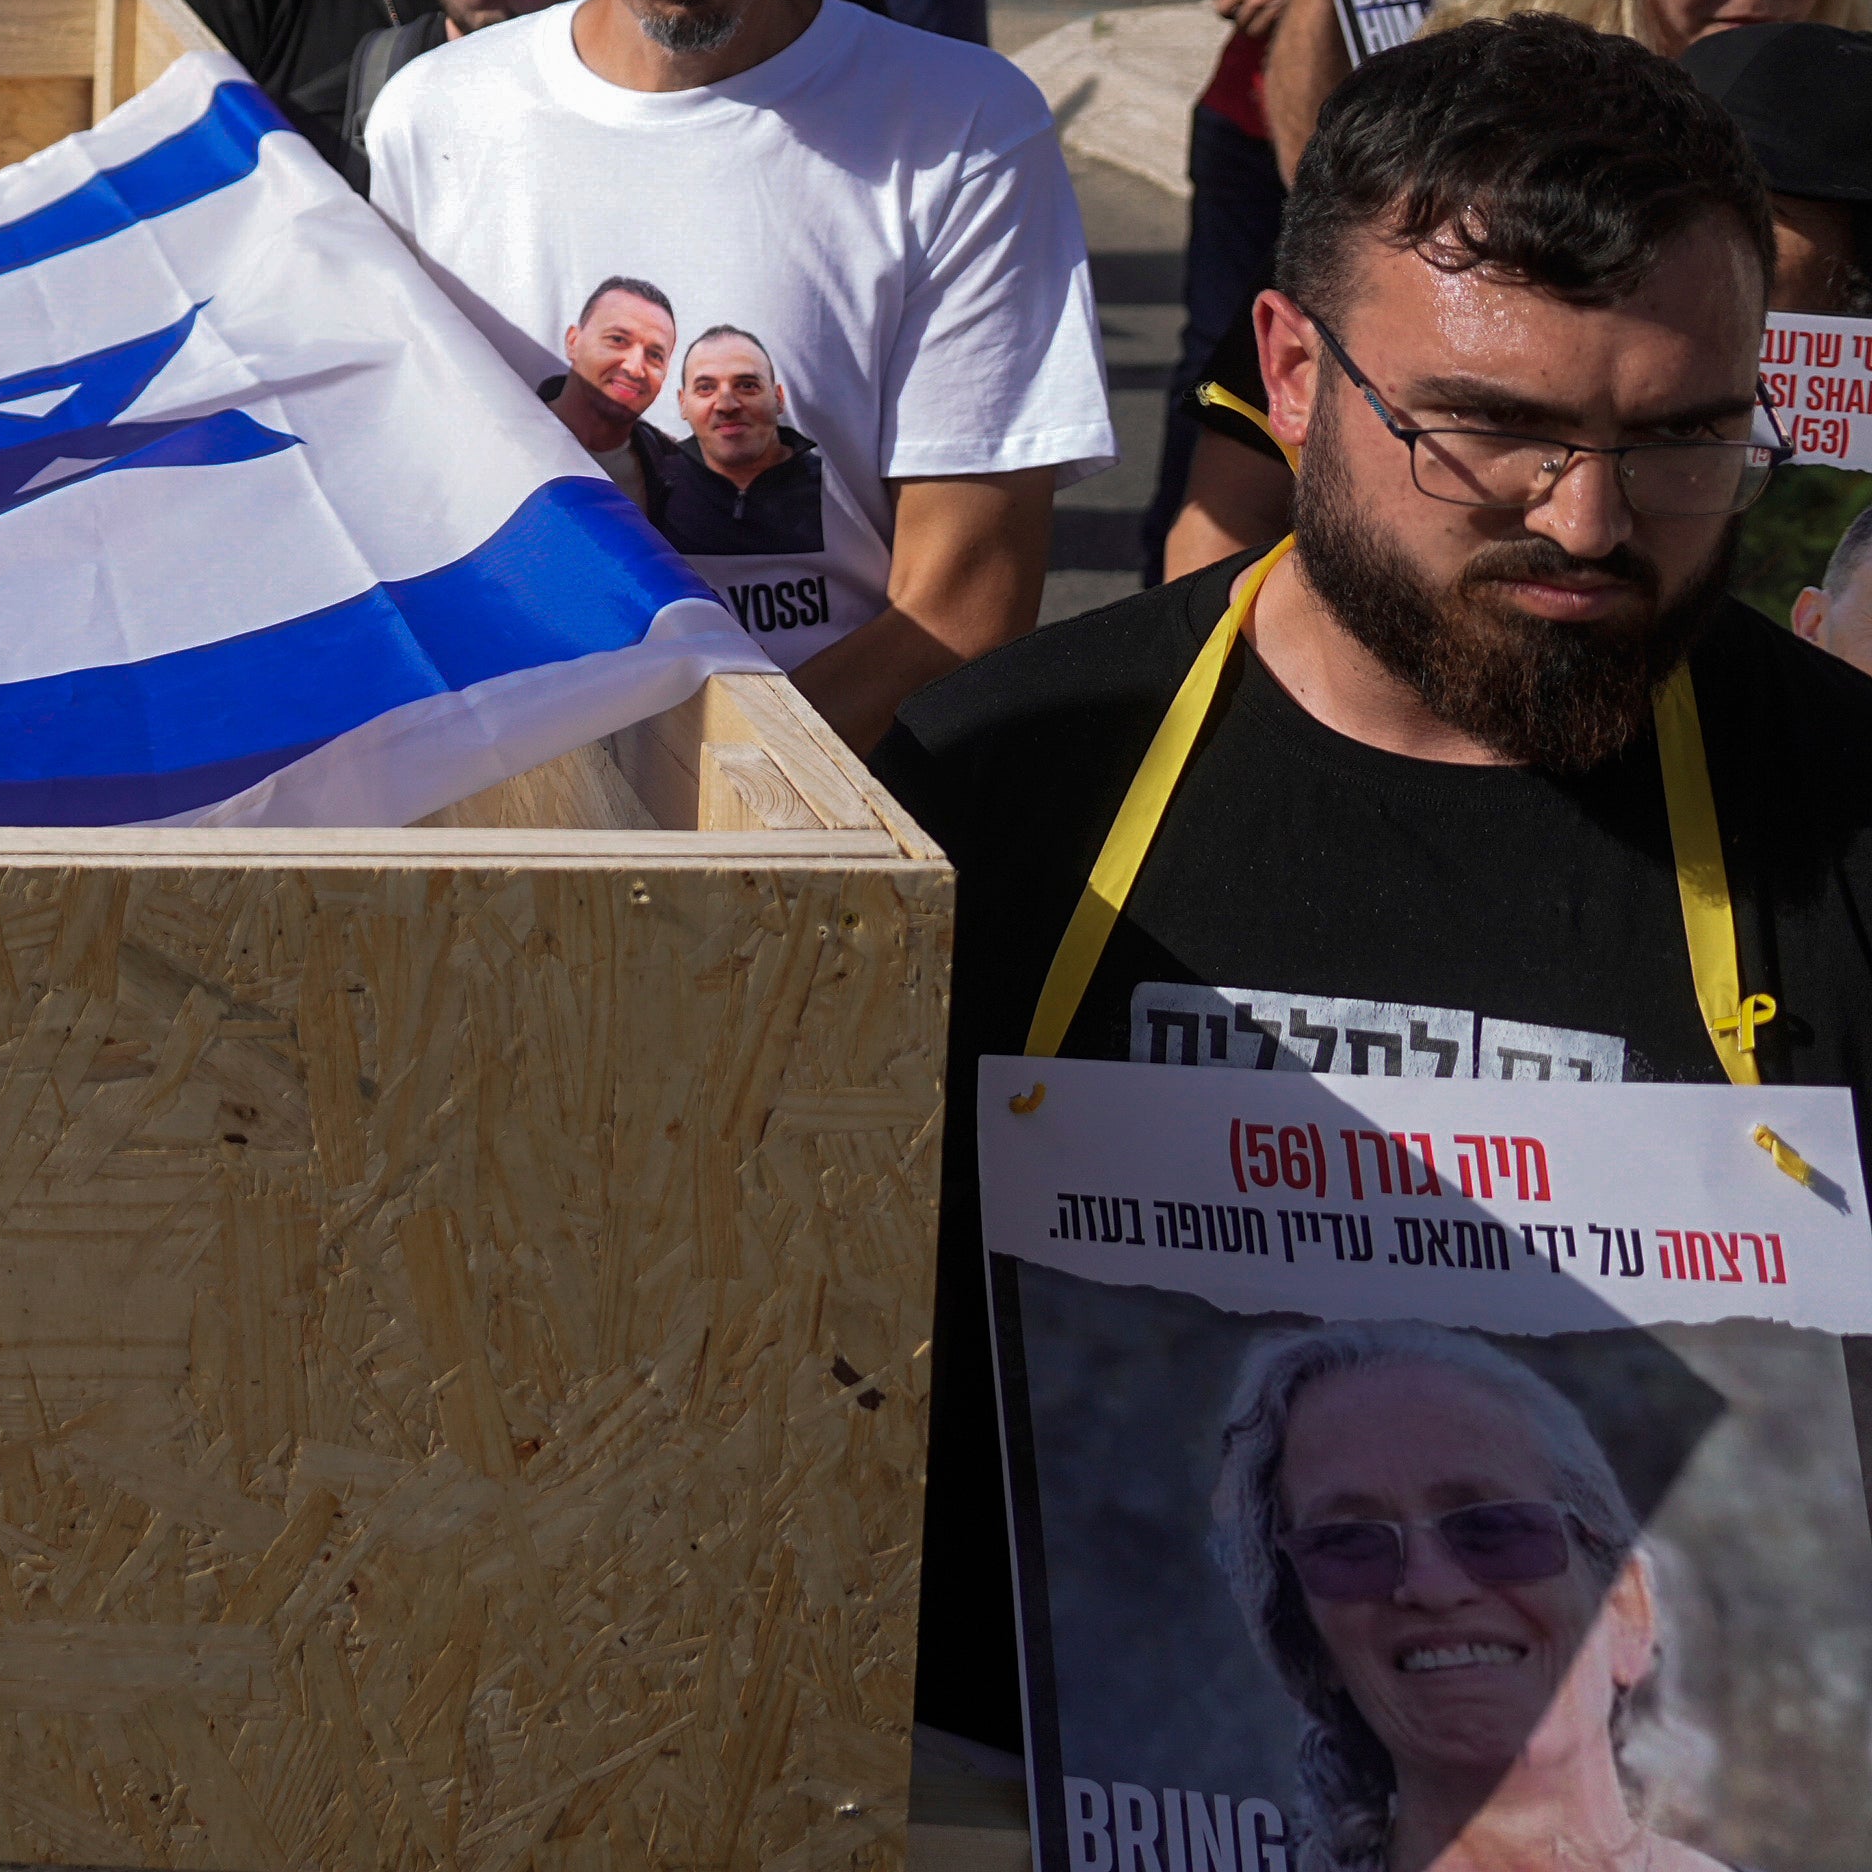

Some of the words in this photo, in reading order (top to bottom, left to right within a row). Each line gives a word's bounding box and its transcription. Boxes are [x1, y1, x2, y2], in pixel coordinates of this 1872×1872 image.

[1759, 329, 1843, 368] שרעב
[1806, 375, 1872, 415] SHA
[1792, 414, 1850, 459] (53)
[727, 575, 829, 634] YOSSI
[1228, 1117, 1329, 1200] (56)
[1339, 1127, 1442, 1202] גורן
[1453, 1131, 1552, 1203] מיה
[1048, 1191, 1147, 1249] בעזה.
[1152, 1199, 1265, 1257] חטופה
[1276, 1209, 1375, 1264] עדיין
[1387, 1216, 1511, 1272] חמאס.
[1520, 1221, 1576, 1275] ידי
[1587, 1221, 1645, 1279] על
[1655, 1228, 1787, 1286] נרצחה
[1062, 1775, 1288, 1872] BRING
